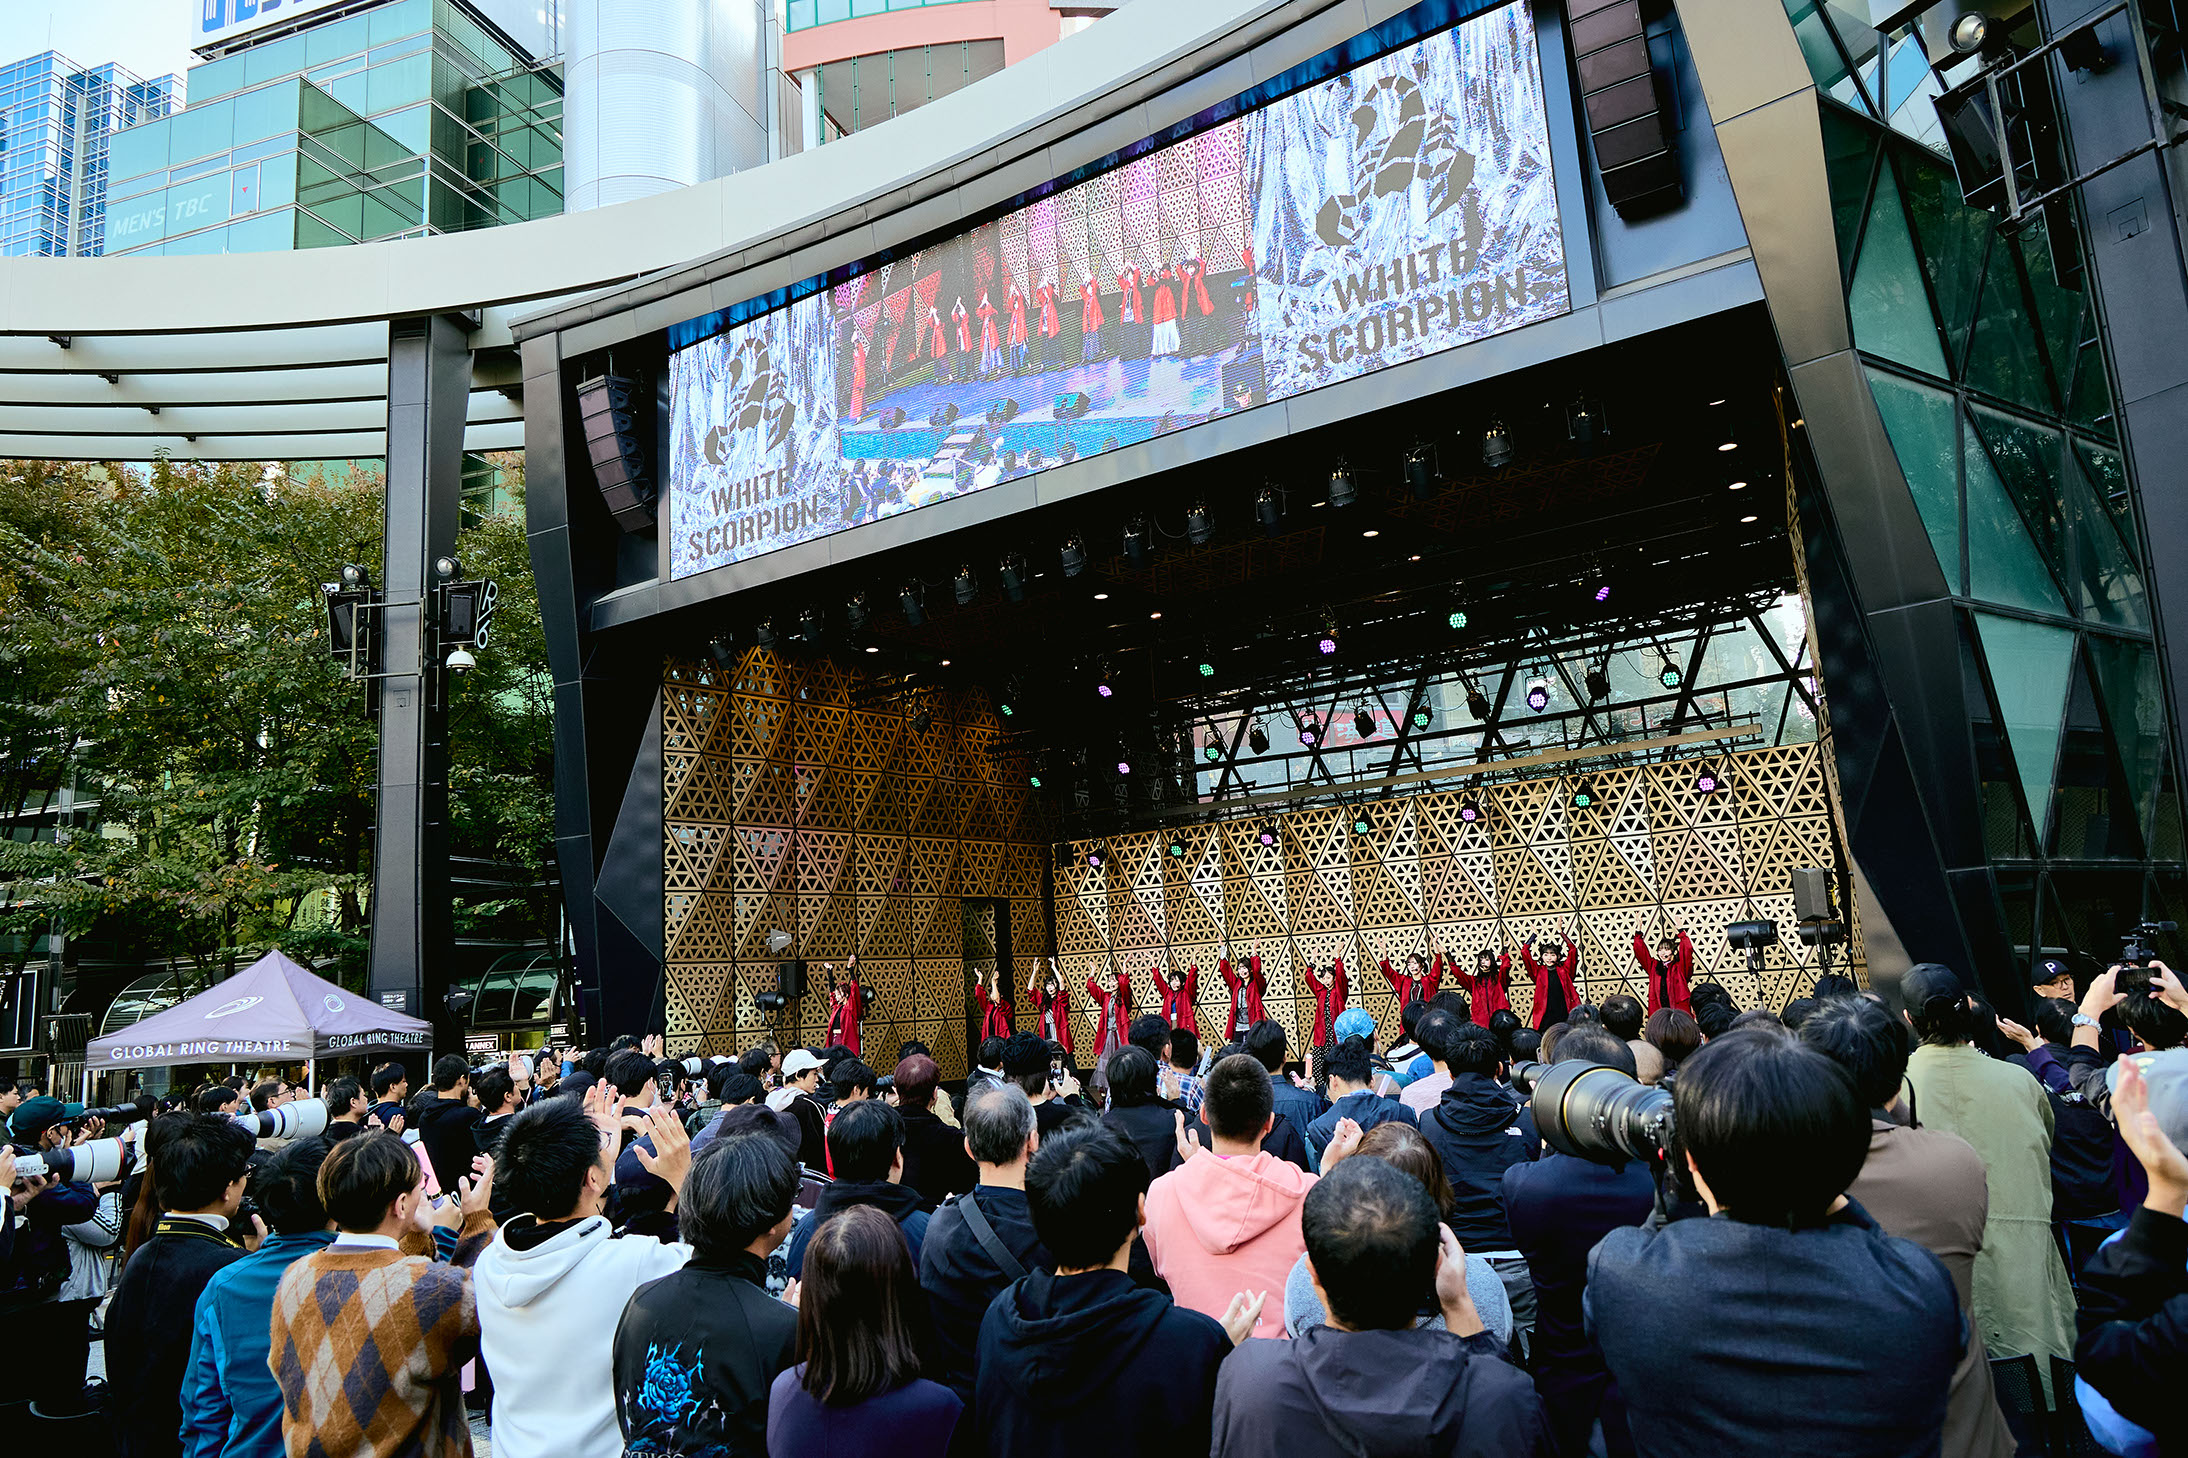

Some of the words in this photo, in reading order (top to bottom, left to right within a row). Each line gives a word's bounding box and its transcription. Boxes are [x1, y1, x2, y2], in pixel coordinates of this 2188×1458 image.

[112, 206, 166, 238] MEN'S
[175, 193, 213, 221] TBC
[1332, 238, 1479, 313] WHITE
[1298, 267, 1528, 373] SCORPION
[711, 466, 791, 517] WHITE
[688, 494, 819, 561] SCORPION
[110, 1044, 174, 1060] GLOBAL
[179, 1041, 220, 1055] RING
[225, 1039, 291, 1053] THEATRE
[328, 1035, 366, 1049] GLOBAL
[366, 1032, 388, 1045] RING
[390, 1032, 424, 1044] THEATRE
[469, 1041, 495, 1050] ANNEX
